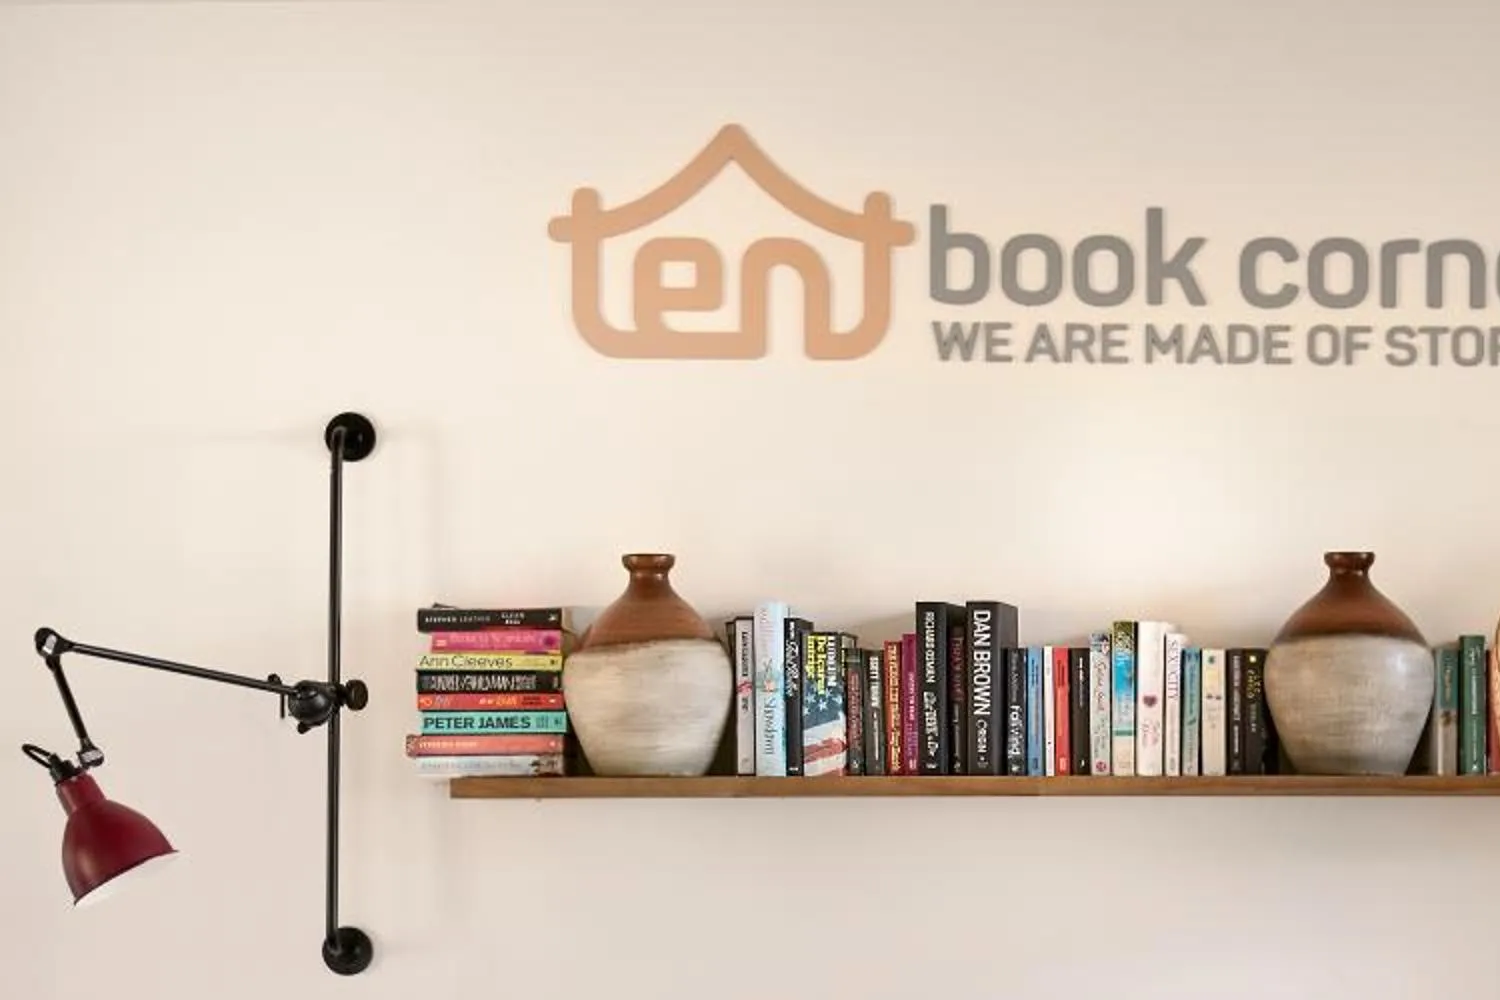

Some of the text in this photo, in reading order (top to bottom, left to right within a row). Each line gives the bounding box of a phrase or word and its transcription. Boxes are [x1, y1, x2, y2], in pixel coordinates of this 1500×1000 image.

[929, 203, 1207, 307] book
[931, 320, 1013, 363] WE
[1024, 322, 1129, 364] ARE
[1145, 323, 1293, 365] MADE
[1306, 324, 1373, 366] OF
[972, 610, 991, 646] DAN
[419, 655, 450, 668] Ann
[451, 654, 513, 668] Cleeves
[972, 650, 991, 716] BROWN
[423, 716, 531, 729] PETER JAMES
